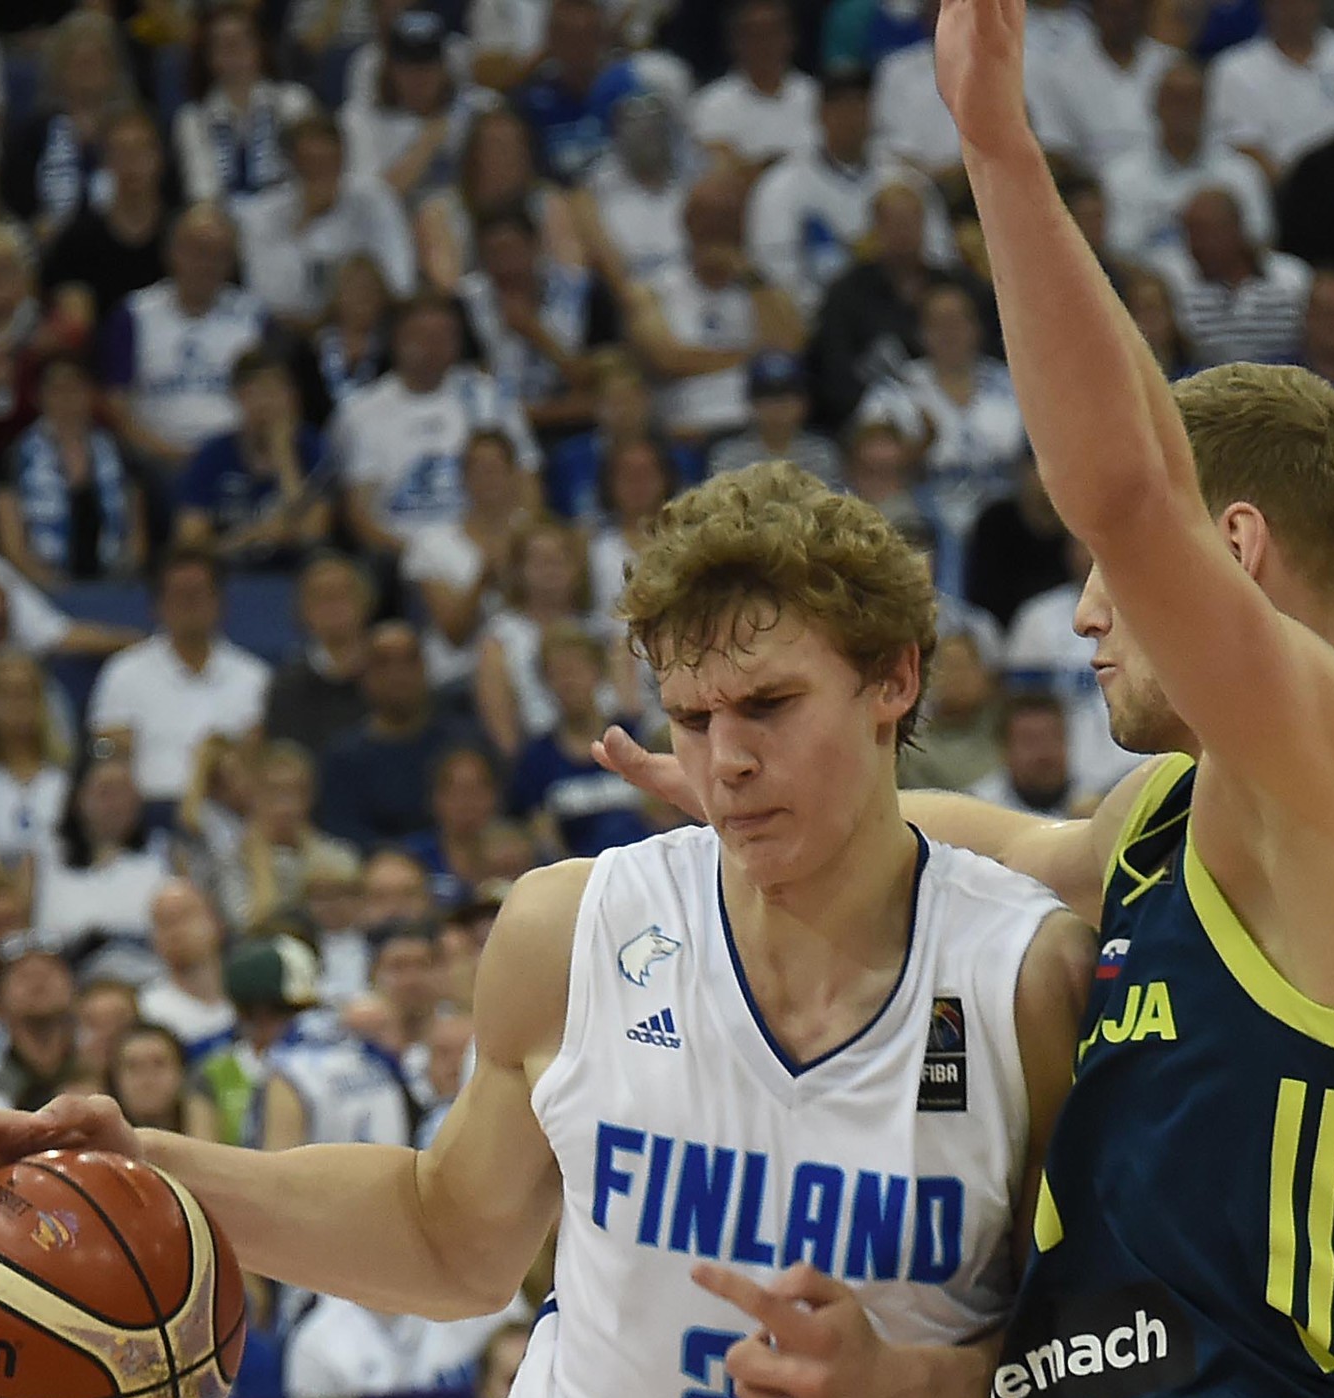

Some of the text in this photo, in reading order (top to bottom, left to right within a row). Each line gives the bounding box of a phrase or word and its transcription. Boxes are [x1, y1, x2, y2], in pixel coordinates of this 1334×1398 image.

[626, 1027, 682, 1049] adidas
[921, 1063, 959, 1083] FIBA
[592, 1120, 966, 1285] FINLAND
